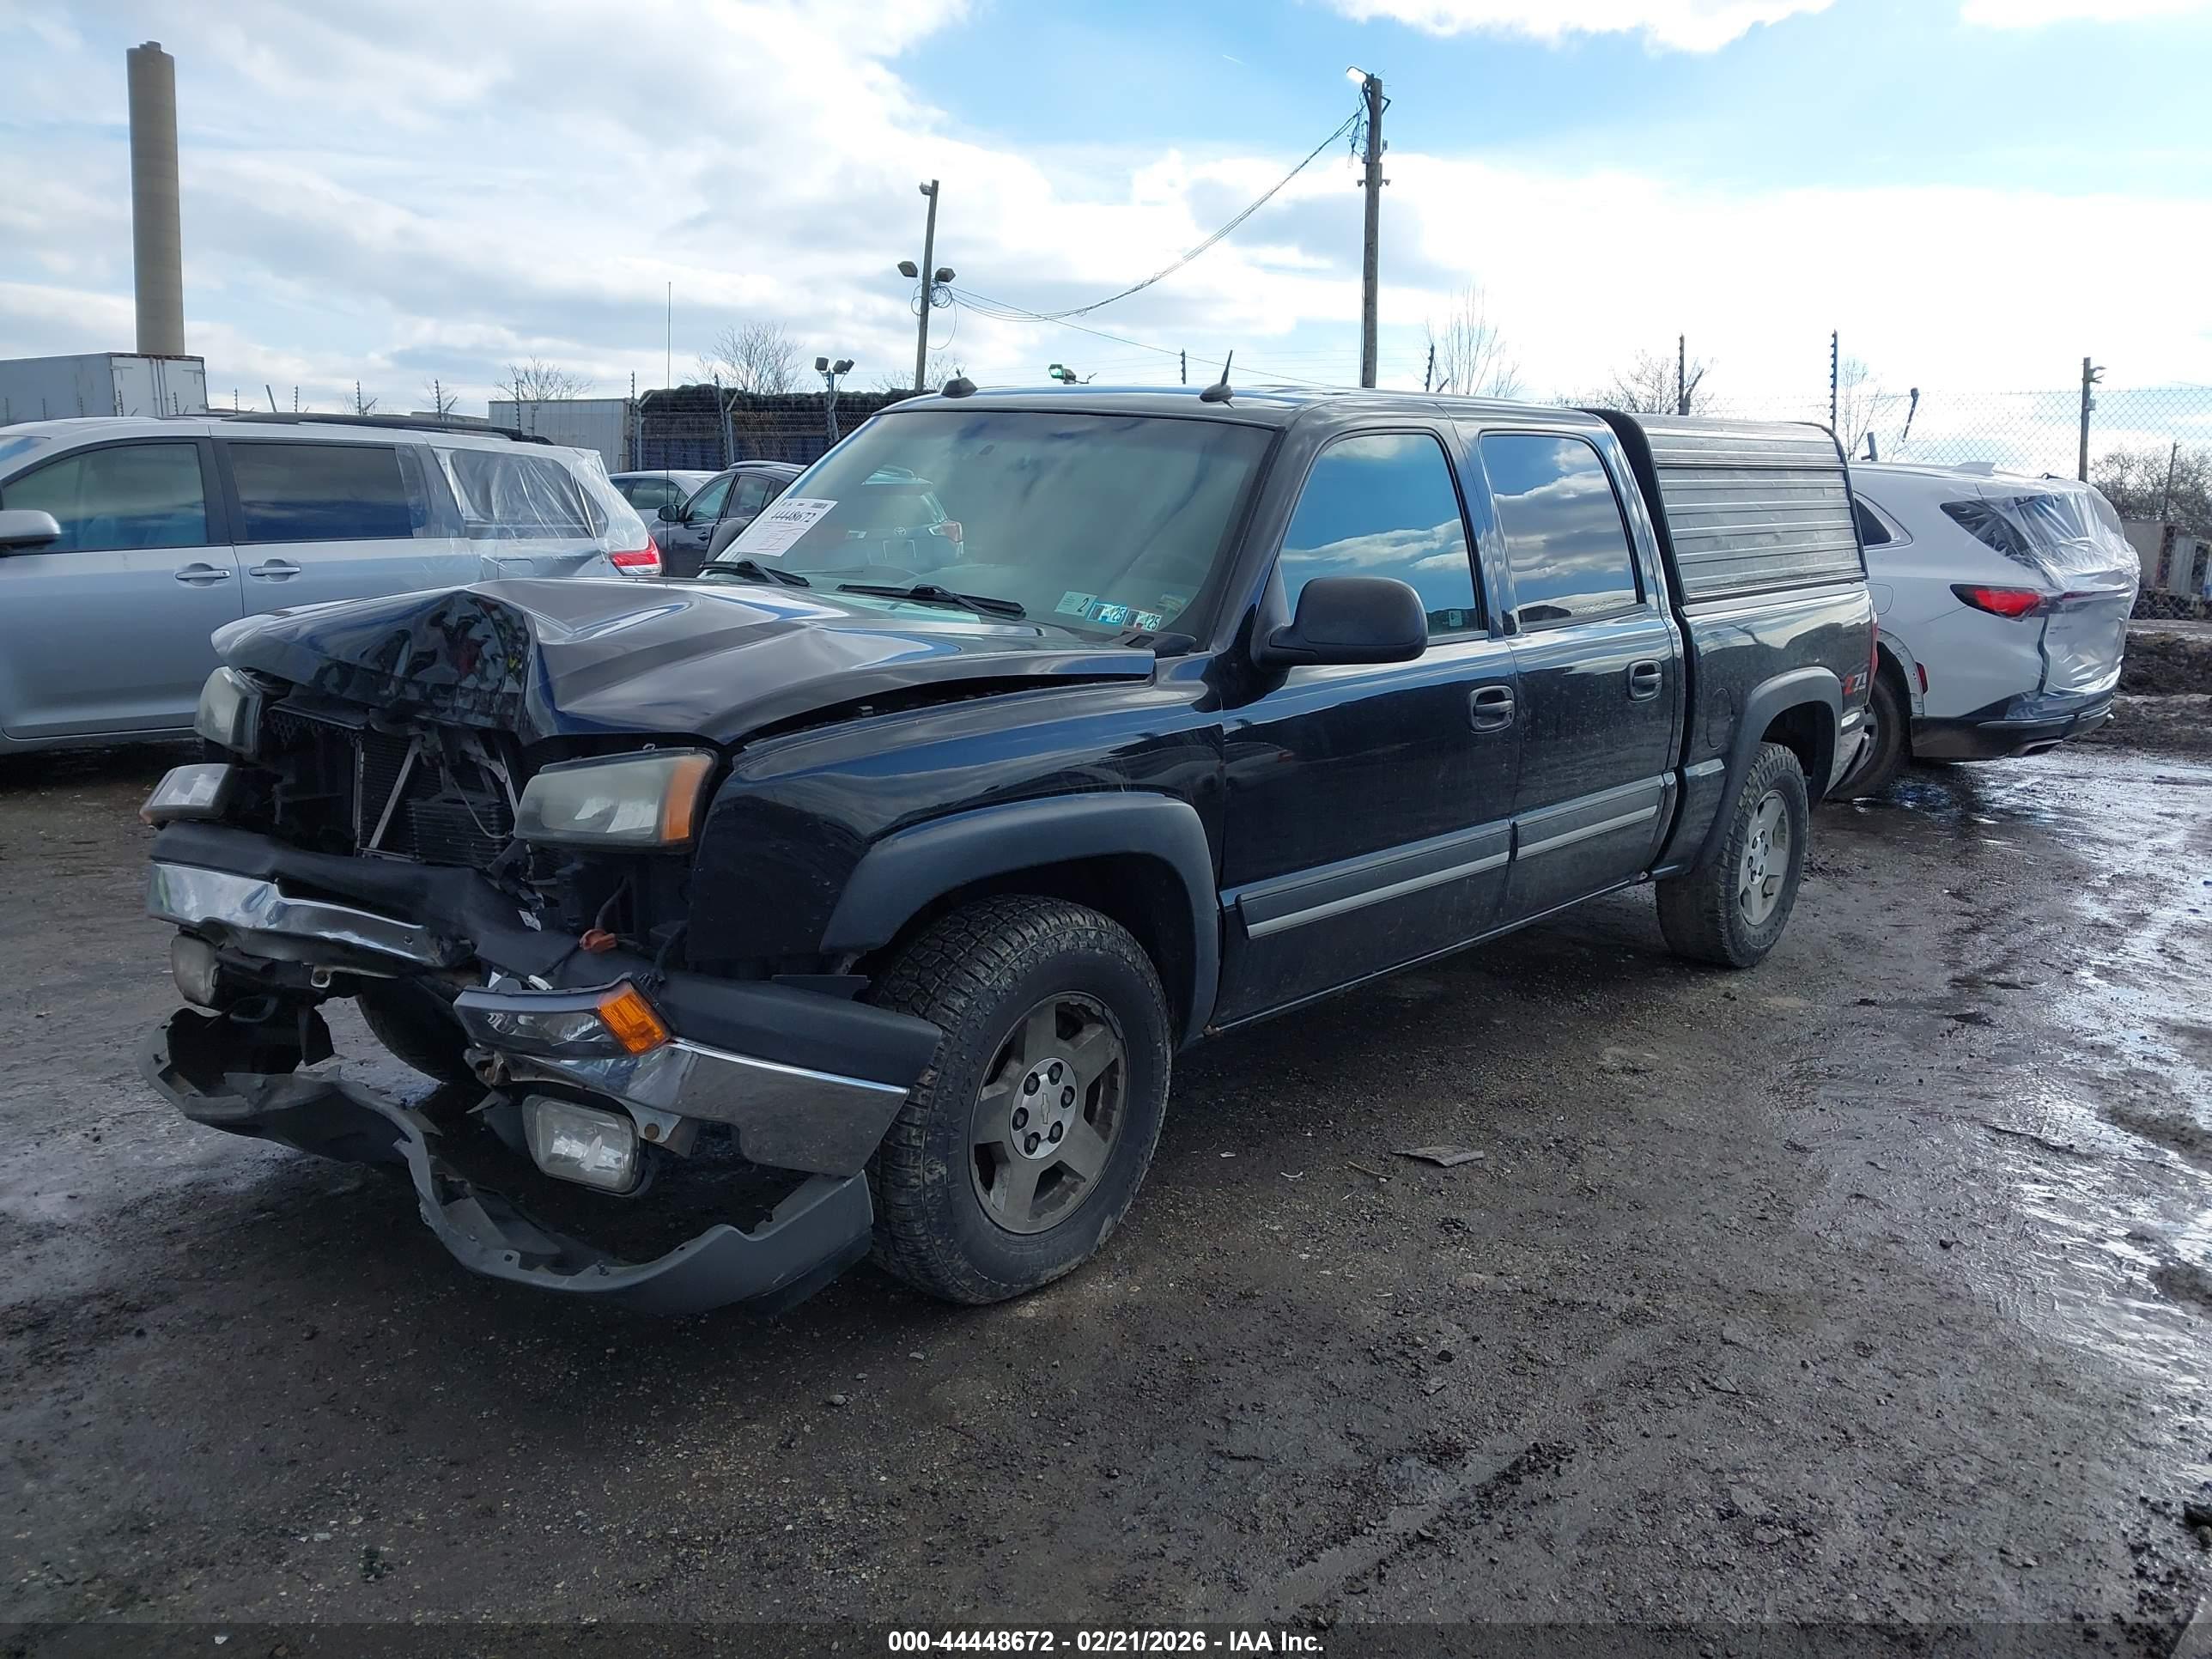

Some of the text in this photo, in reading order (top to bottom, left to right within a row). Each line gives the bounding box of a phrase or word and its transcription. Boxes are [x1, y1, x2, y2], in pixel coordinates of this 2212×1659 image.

[770, 509, 817, 523] 44448672
[1077, 597, 1089, 612] 2
[1112, 607, 1126, 622] 25
[1147, 615, 1160, 629] 25
